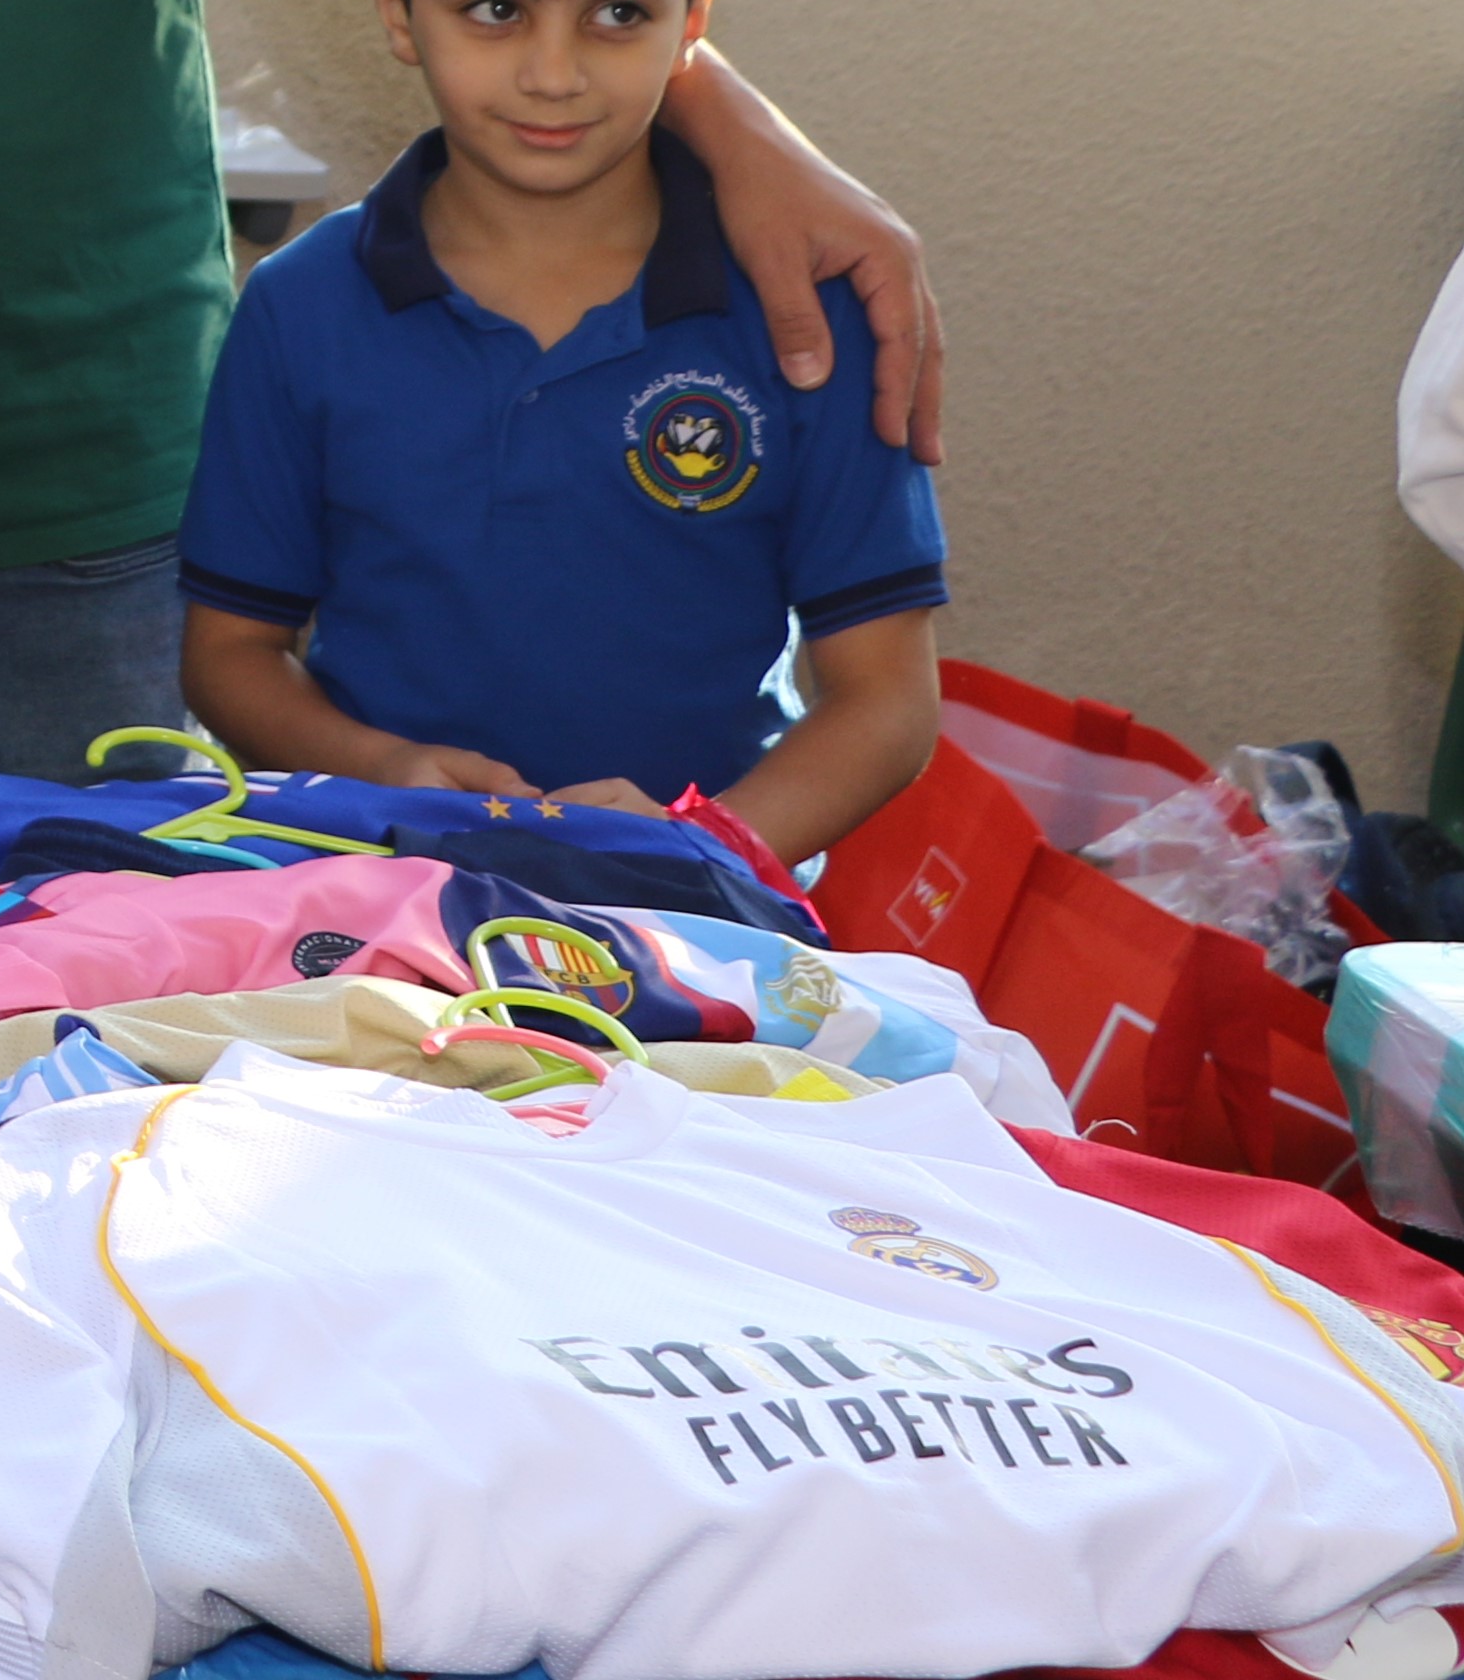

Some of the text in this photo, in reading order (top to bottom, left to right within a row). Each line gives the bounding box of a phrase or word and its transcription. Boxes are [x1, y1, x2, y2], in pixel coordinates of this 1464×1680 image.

[517, 1325, 1134, 1399] Emirates
[685, 1388, 1130, 1486] FLY BETTER
